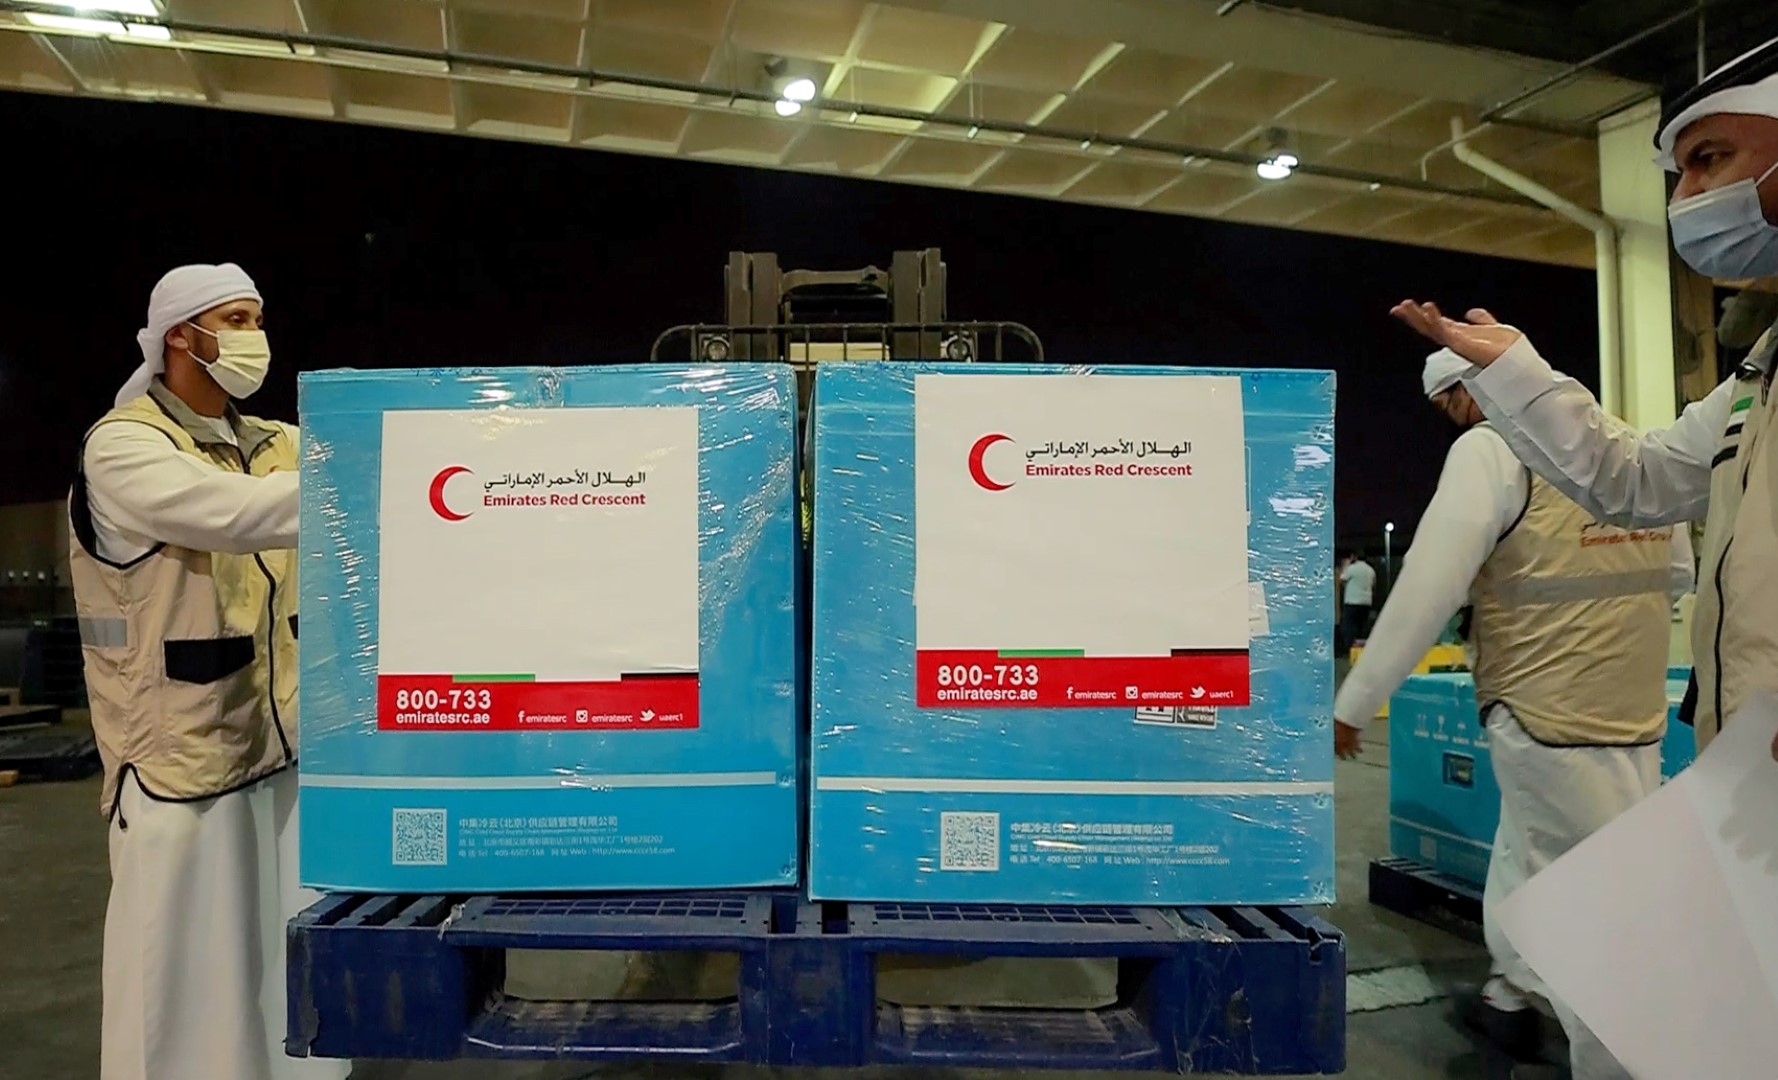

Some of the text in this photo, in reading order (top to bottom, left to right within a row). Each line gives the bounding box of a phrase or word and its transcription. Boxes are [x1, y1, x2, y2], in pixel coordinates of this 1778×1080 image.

[1091, 438, 1134, 459] الأحمر
[1025, 463, 1193, 477] Emirates Red Crescent
[546, 468, 589, 488] الأحمر
[483, 493, 647, 507] Emirates Red Crescent
[937, 664, 1039, 686] 800-733
[396, 689, 492, 710] 800-733
[936, 687, 1039, 701] emiratesrc.ae
[1074, 689, 1117, 700] emiratesrc
[1141, 689, 1184, 700] emiratesrc
[395, 711, 491, 725] emiratesrc.ae
[525, 713, 568, 724] emiratesrc
[591, 713, 634, 723] emiratesrc
